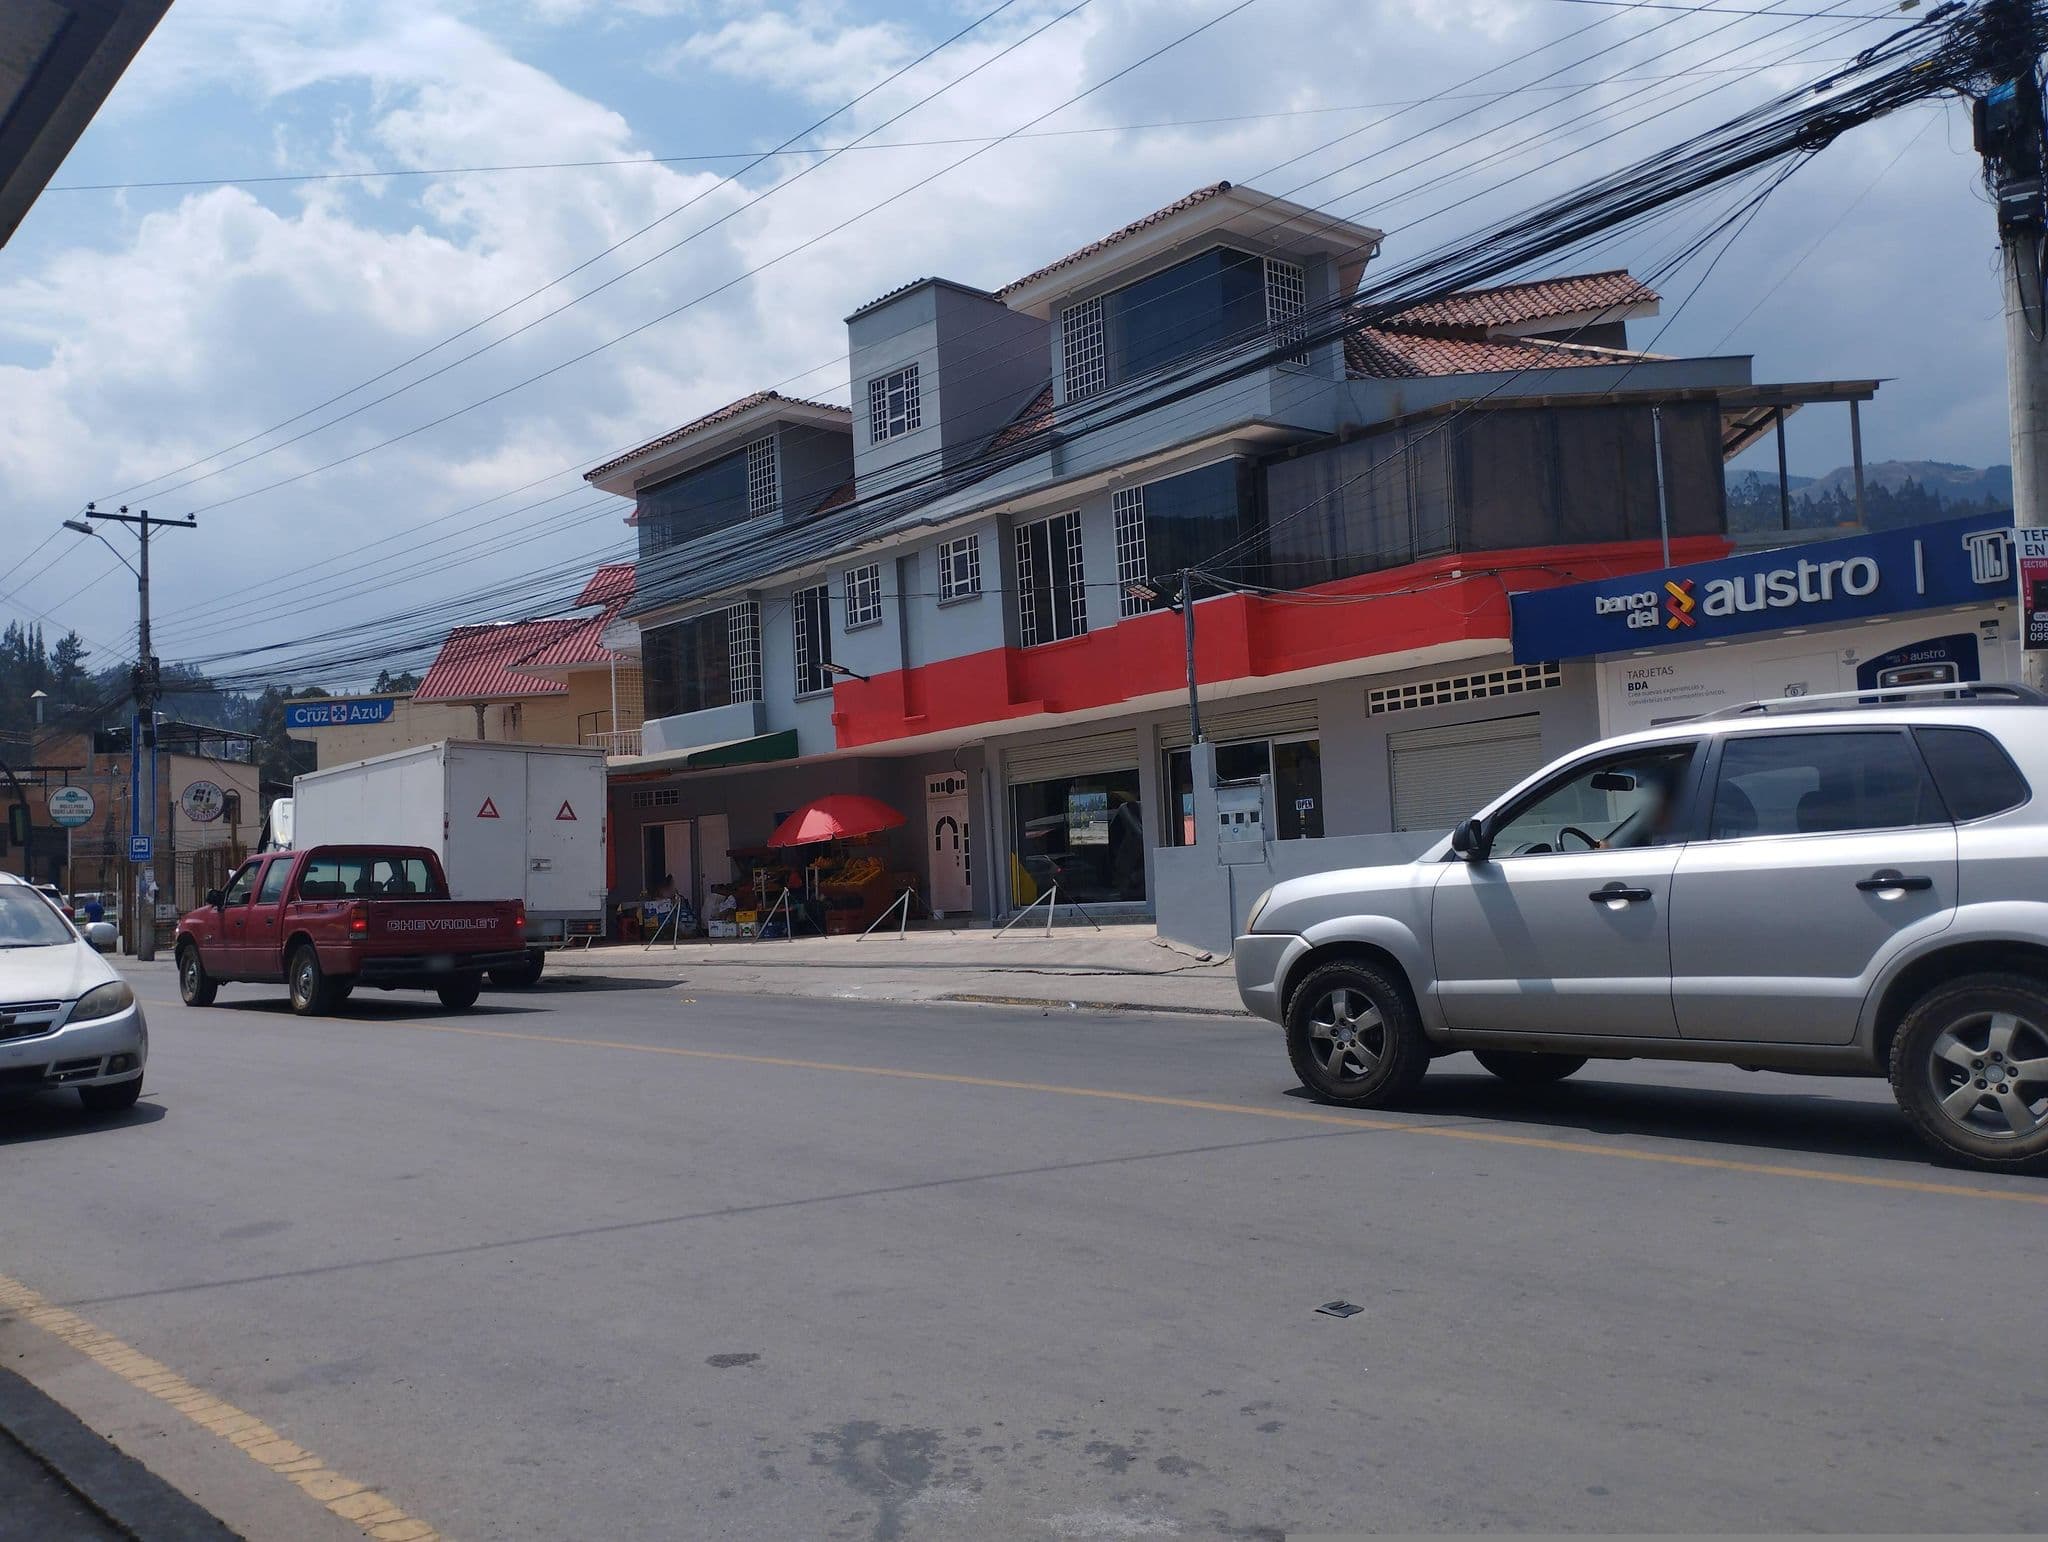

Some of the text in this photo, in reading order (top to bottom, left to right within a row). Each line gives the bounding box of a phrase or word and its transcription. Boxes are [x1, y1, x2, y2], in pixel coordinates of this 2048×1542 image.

[2025, 544, 2046, 556] EN
[1702, 556, 1880, 616] austro
[1595, 590, 1658, 615] banco
[1626, 607, 1660, 629] del
[1910, 649, 1946, 661] austro
[1627, 666, 1674, 680] TARJETAS
[1628, 681, 1648, 691] BDA
[295, 704, 382, 724] Cruz Azul
[1297, 800, 1313, 809] OPEN
[386, 918, 499, 931] CHEVROLET
